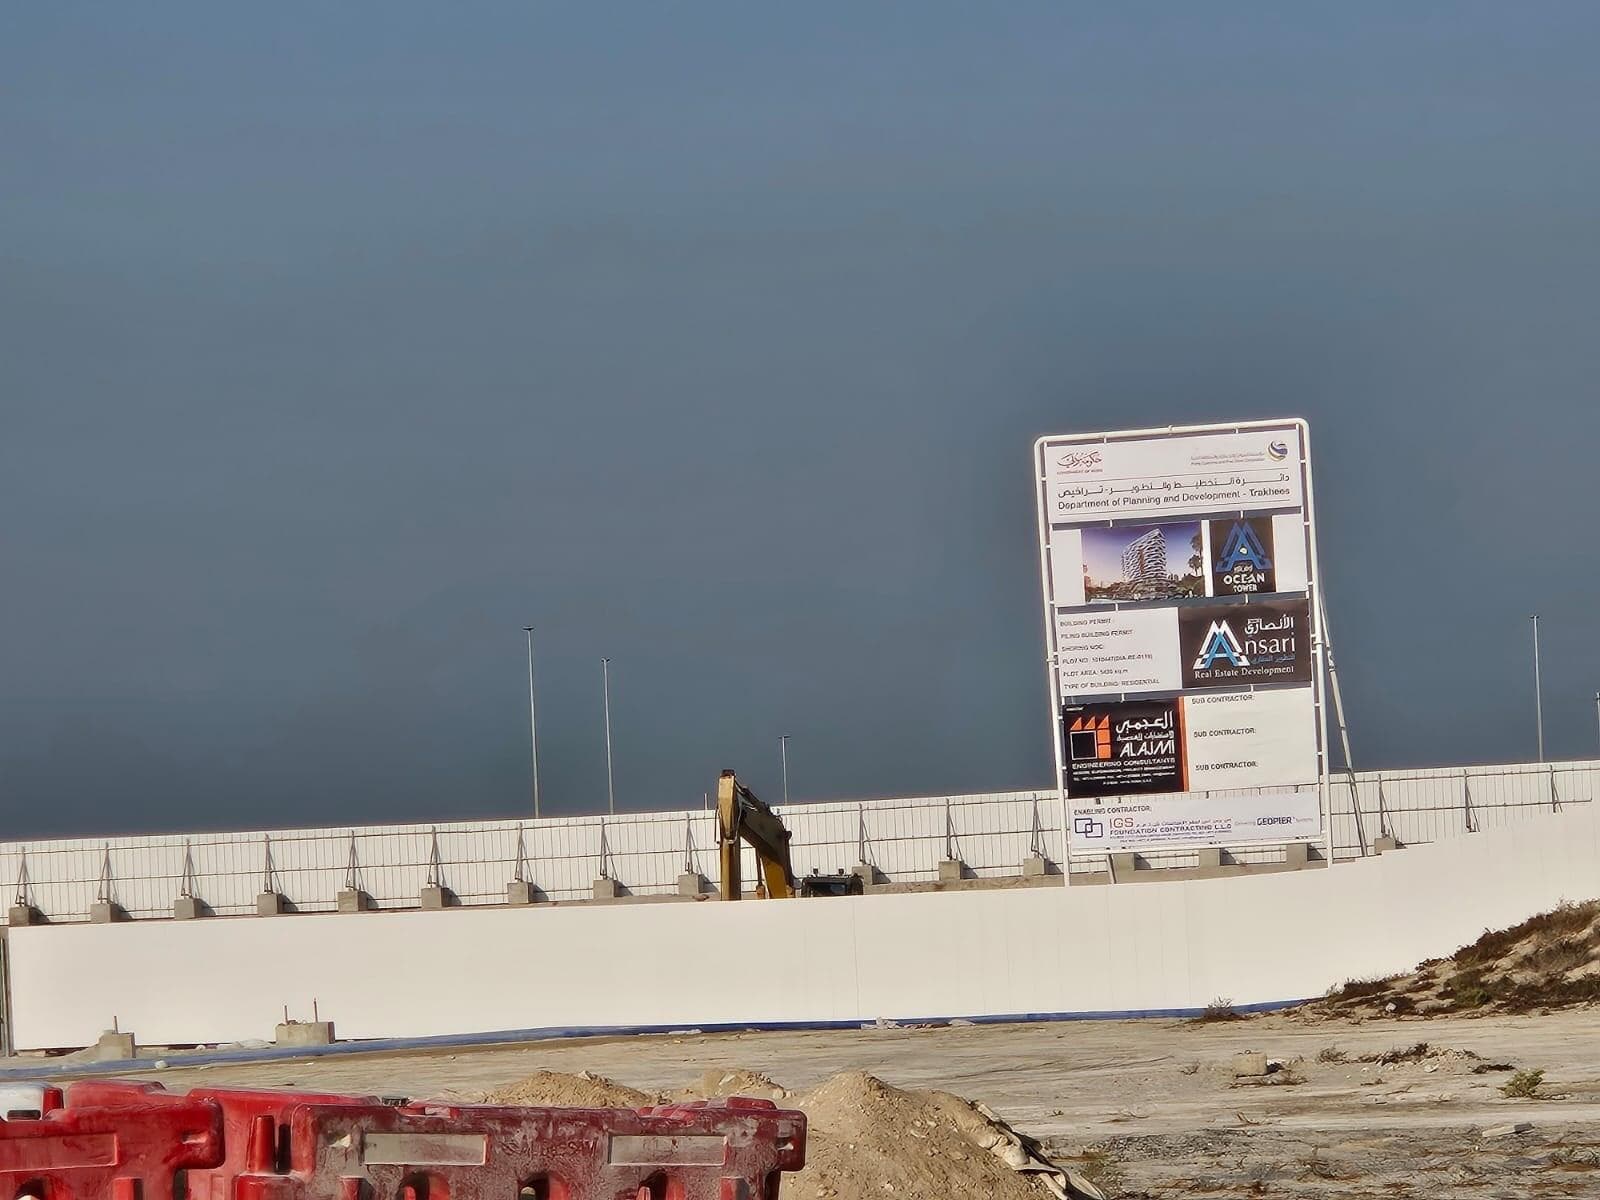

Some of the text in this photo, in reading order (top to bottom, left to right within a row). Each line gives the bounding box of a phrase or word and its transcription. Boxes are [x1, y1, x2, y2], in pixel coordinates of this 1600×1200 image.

[1058, 498, 1109, 510] Department
[1112, 498, 1121, 507] of
[1123, 496, 1161, 505] Planning
[1163, 494, 1180, 503] and
[1182, 490, 1241, 502] Development
[1249, 487, 1290, 497] Trakhees
[1223, 572, 1265, 585] OCEAN
[1233, 584, 1258, 593] TOWER
[1060, 619, 1088, 627] BUILDING
[1081, 630, 1109, 638] BUILDING
[1062, 657, 1079, 665] PLOT
[1194, 665, 1294, 679] Real Estate Development
[1116, 710, 1174, 734] العجمي
[1193, 730, 1207, 738] SUB
[1120, 739, 1176, 758] ALAJMI
[1072, 757, 1176, 770] ENGINEERING CONSULTANTS
[1073, 807, 1106, 816] ENABLING
[1109, 817, 1135, 829] IGS
[1110, 827, 1158, 836] FOUNDATION
[1159, 824, 1213, 833] CONTRACTING
